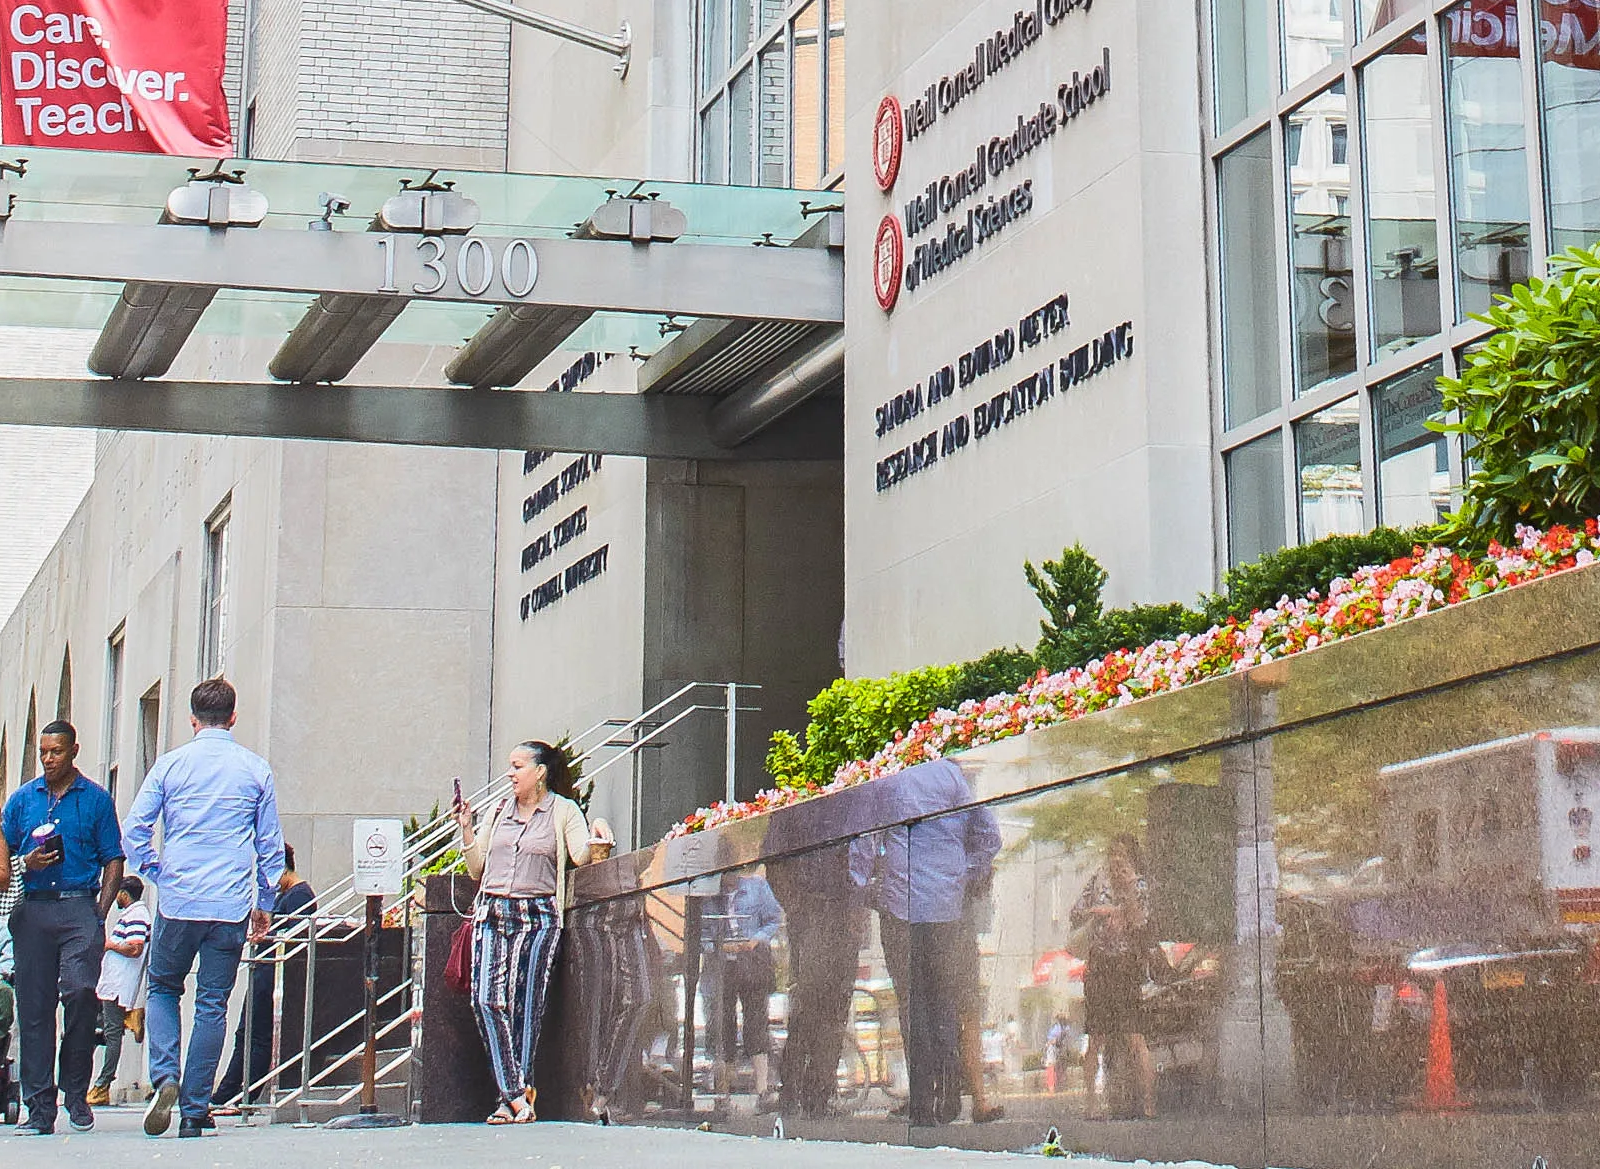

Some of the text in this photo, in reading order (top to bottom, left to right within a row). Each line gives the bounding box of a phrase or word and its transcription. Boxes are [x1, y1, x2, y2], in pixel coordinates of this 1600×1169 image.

[904, 84, 937, 142] Weill
[938, 43, 985, 114] Cornell
[904, 181, 938, 238] Weill
[939, 144, 986, 213] Cornell
[987, 102, 1057, 177] Graduate
[1057, 47, 1111, 125] School
[377, 234, 538, 298] 1300
[905, 245, 920, 291] of
[920, 209, 973, 281] Medical
[974, 179, 1033, 244] Sciences
[875, 292, 1071, 438] SANDRA AND EDWARD MEYER
[876, 320, 1134, 493] RESEARCH AND EDUCATION BUILDING
